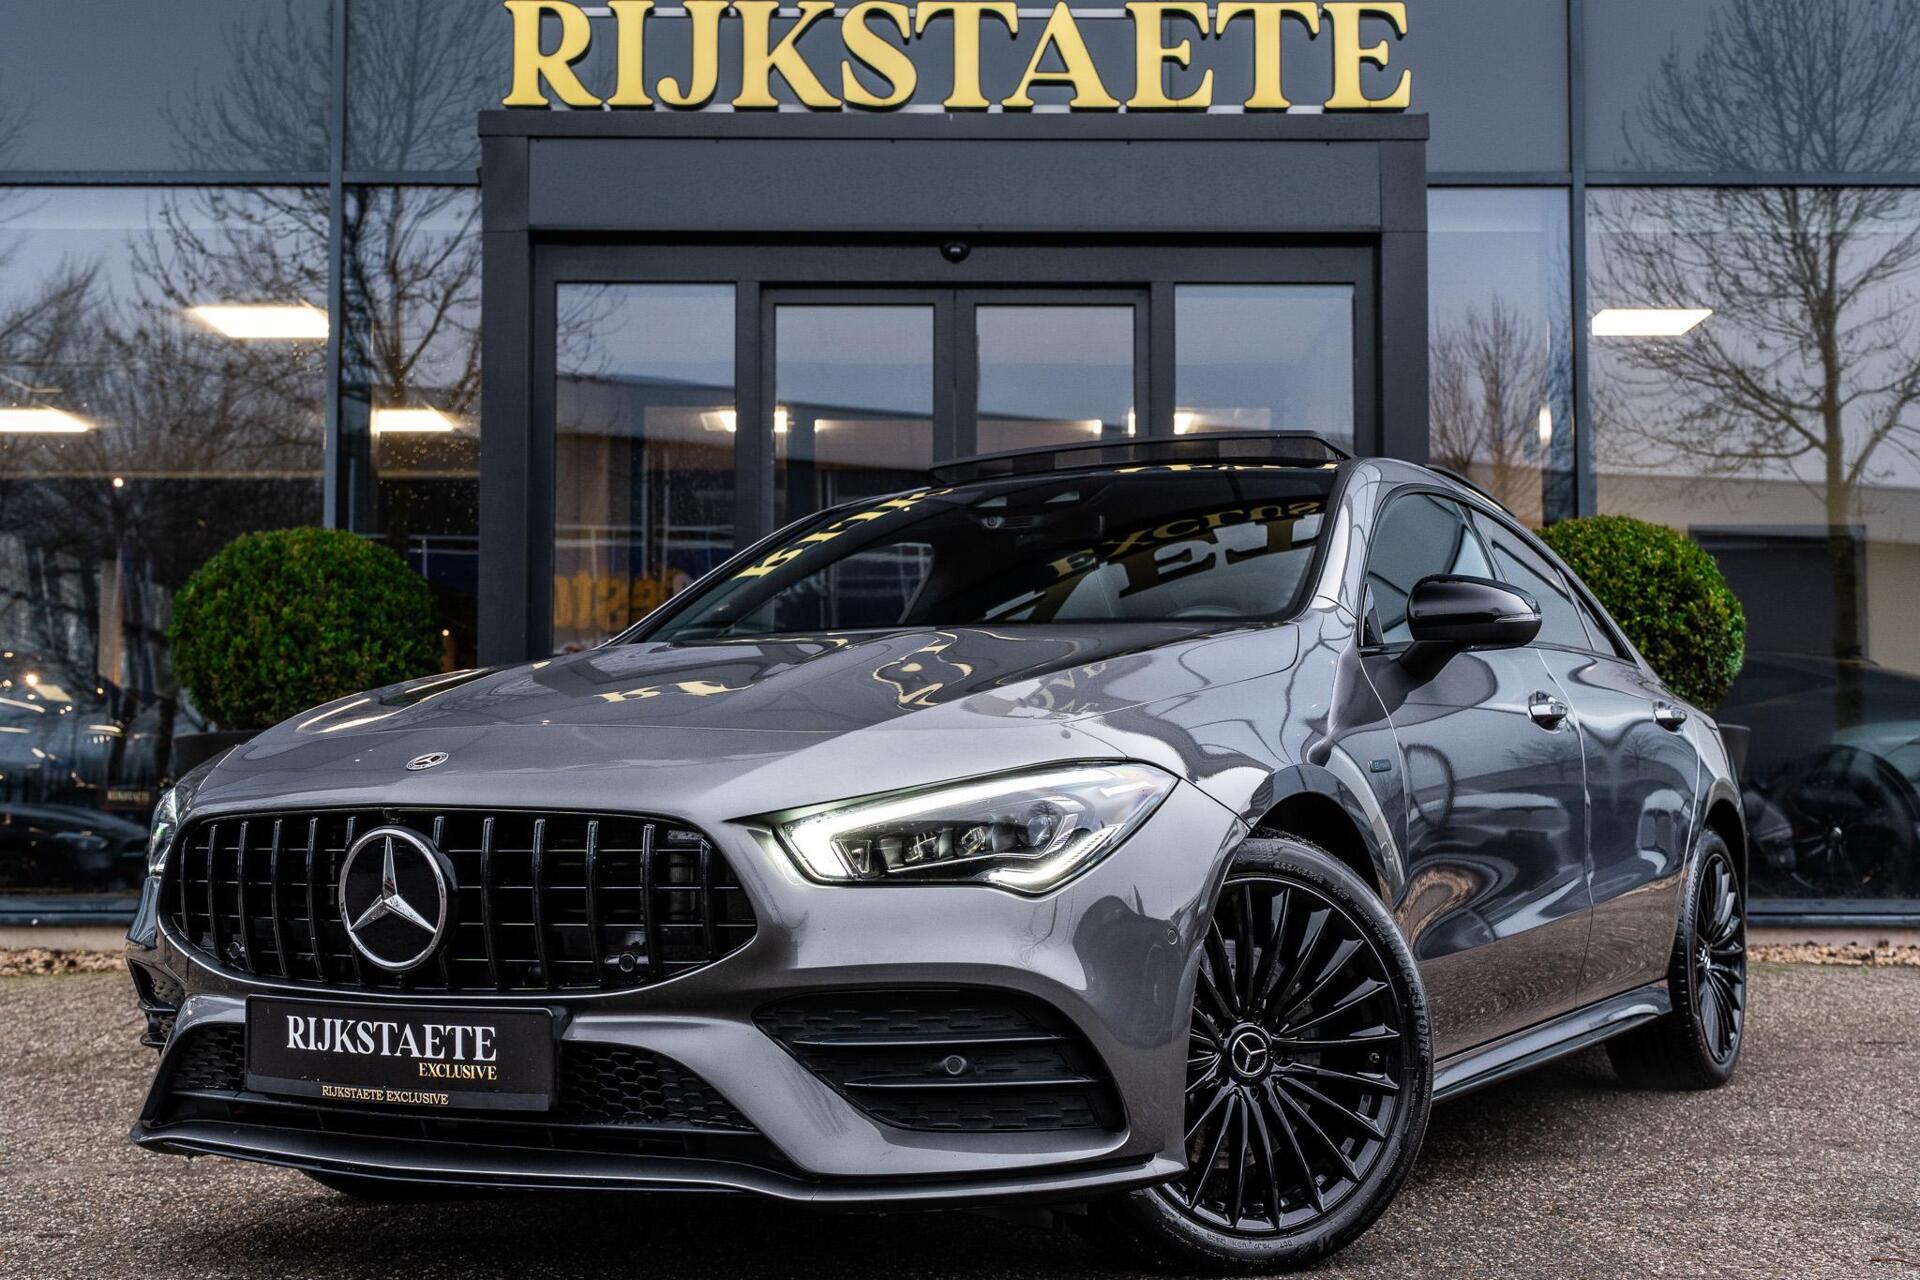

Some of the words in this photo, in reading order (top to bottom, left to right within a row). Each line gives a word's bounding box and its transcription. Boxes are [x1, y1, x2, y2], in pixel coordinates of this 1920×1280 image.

[502, 0, 1412, 109] RIJKSTAETE
[286, 1015, 497, 1062] RIJKSTAETE
[418, 1062, 497, 1080] EXCLUSIVE
[321, 1085, 384, 1101] RIJKSTAETE
[386, 1090, 449, 1105] EXCLUSIVE
